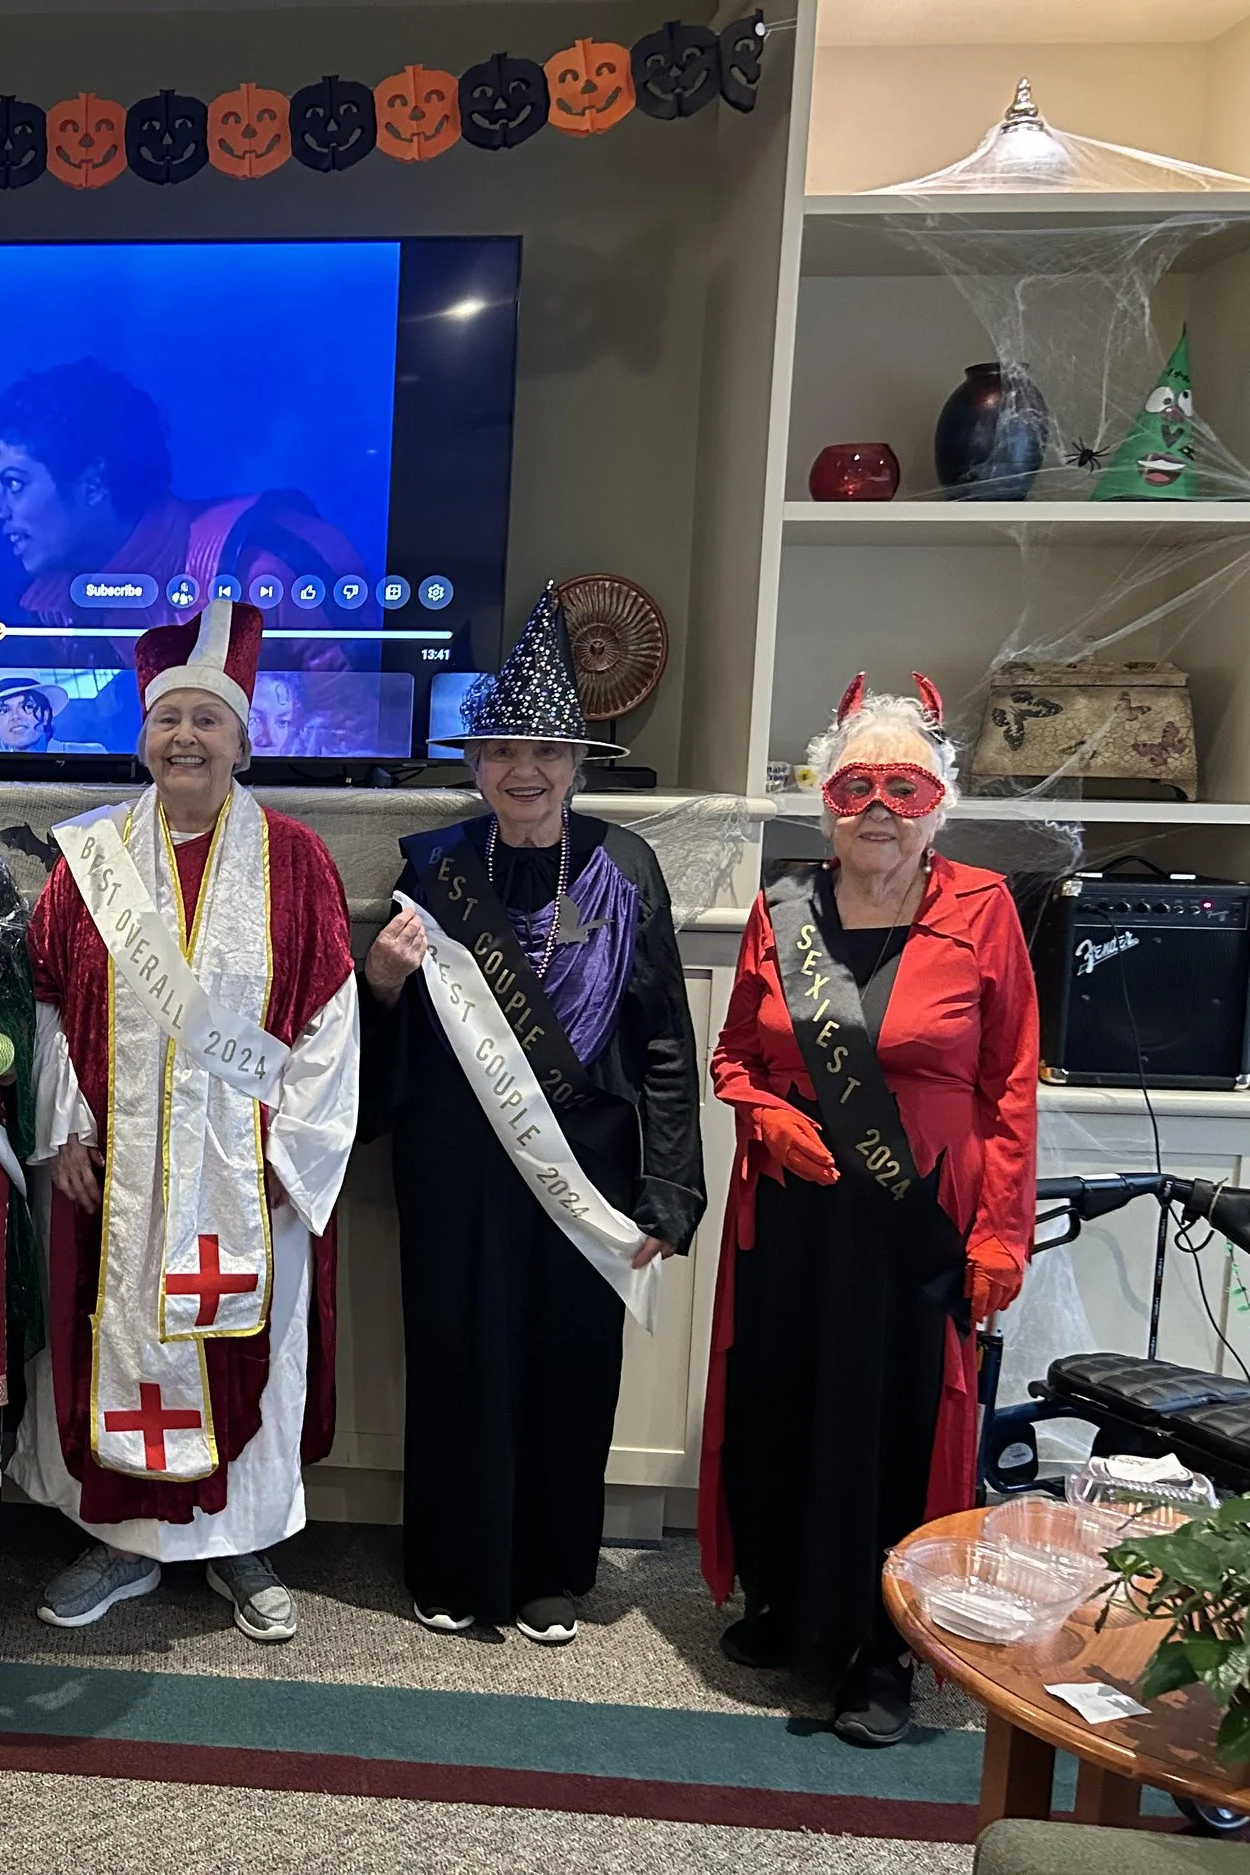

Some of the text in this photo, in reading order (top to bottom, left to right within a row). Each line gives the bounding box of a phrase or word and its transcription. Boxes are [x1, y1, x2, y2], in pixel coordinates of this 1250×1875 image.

[86, 584, 143, 597] Subscribe
[421, 649, 451, 660] 13:41
[80, 836, 267, 1081] BEST OVERALL 2024
[428, 845, 479, 922] BEST
[473, 931, 546, 1052] COUPLE
[1074, 930, 1140, 976] Fender
[475, 1037, 542, 1148] COUPLE
[536, 1166, 591, 1220] 2024
[796, 924, 912, 1201] SEXIEST 2024
